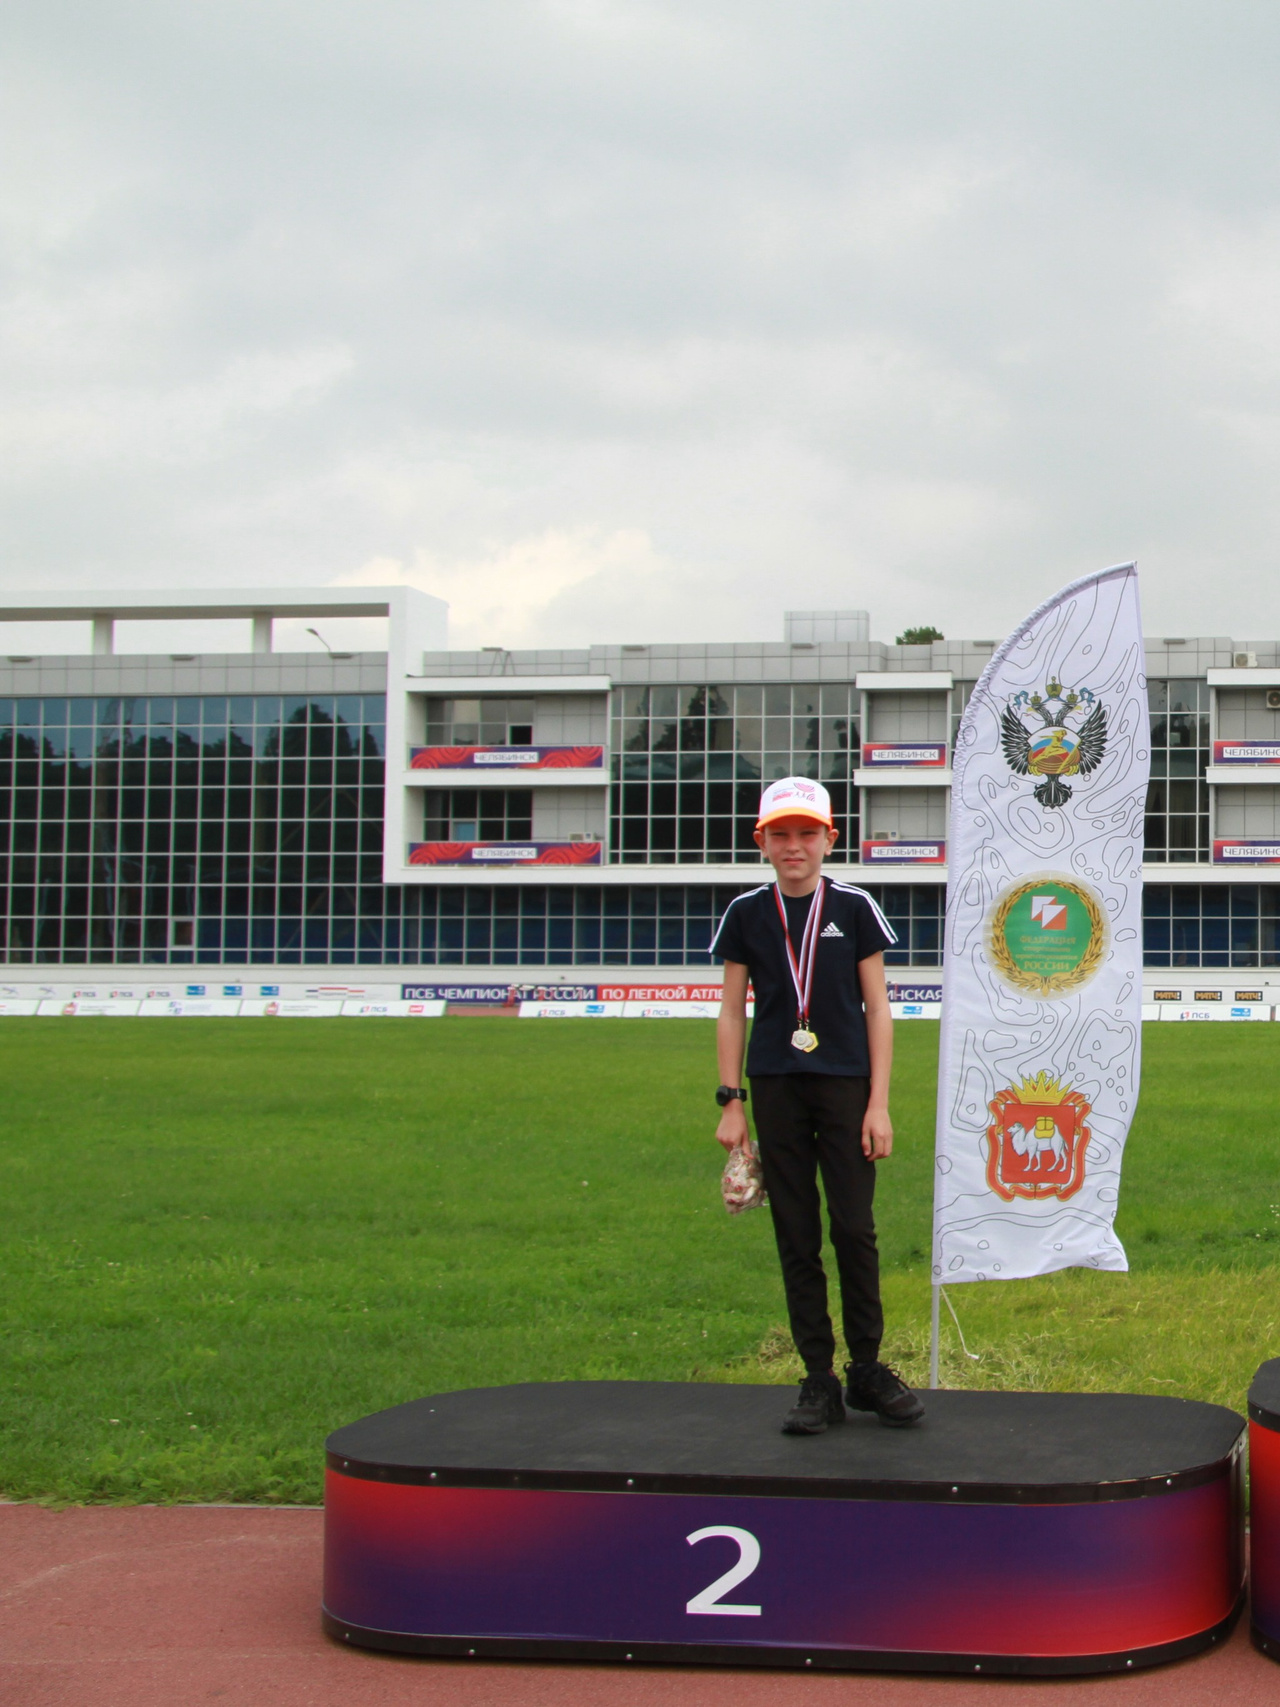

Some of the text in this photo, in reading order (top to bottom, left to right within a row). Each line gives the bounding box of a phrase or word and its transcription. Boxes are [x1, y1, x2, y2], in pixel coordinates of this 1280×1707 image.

[475, 753, 536, 762] ЧЕЛЯБИНСК
[873, 750, 937, 759] ЧЕЛЯБИНСК
[473, 849, 535, 857] ЧЕЛЯБИНСК
[872, 847, 936, 856] ЧЕЛЯБИНСК
[405, 988, 435, 999] ПСБ
[438, 988, 528, 999] ЧЕМПИОНАТ
[602, 989, 624, 1000] ПО
[627, 986, 688, 1000] ЛЕГКОЙ
[686, 1525, 761, 1615] 2
